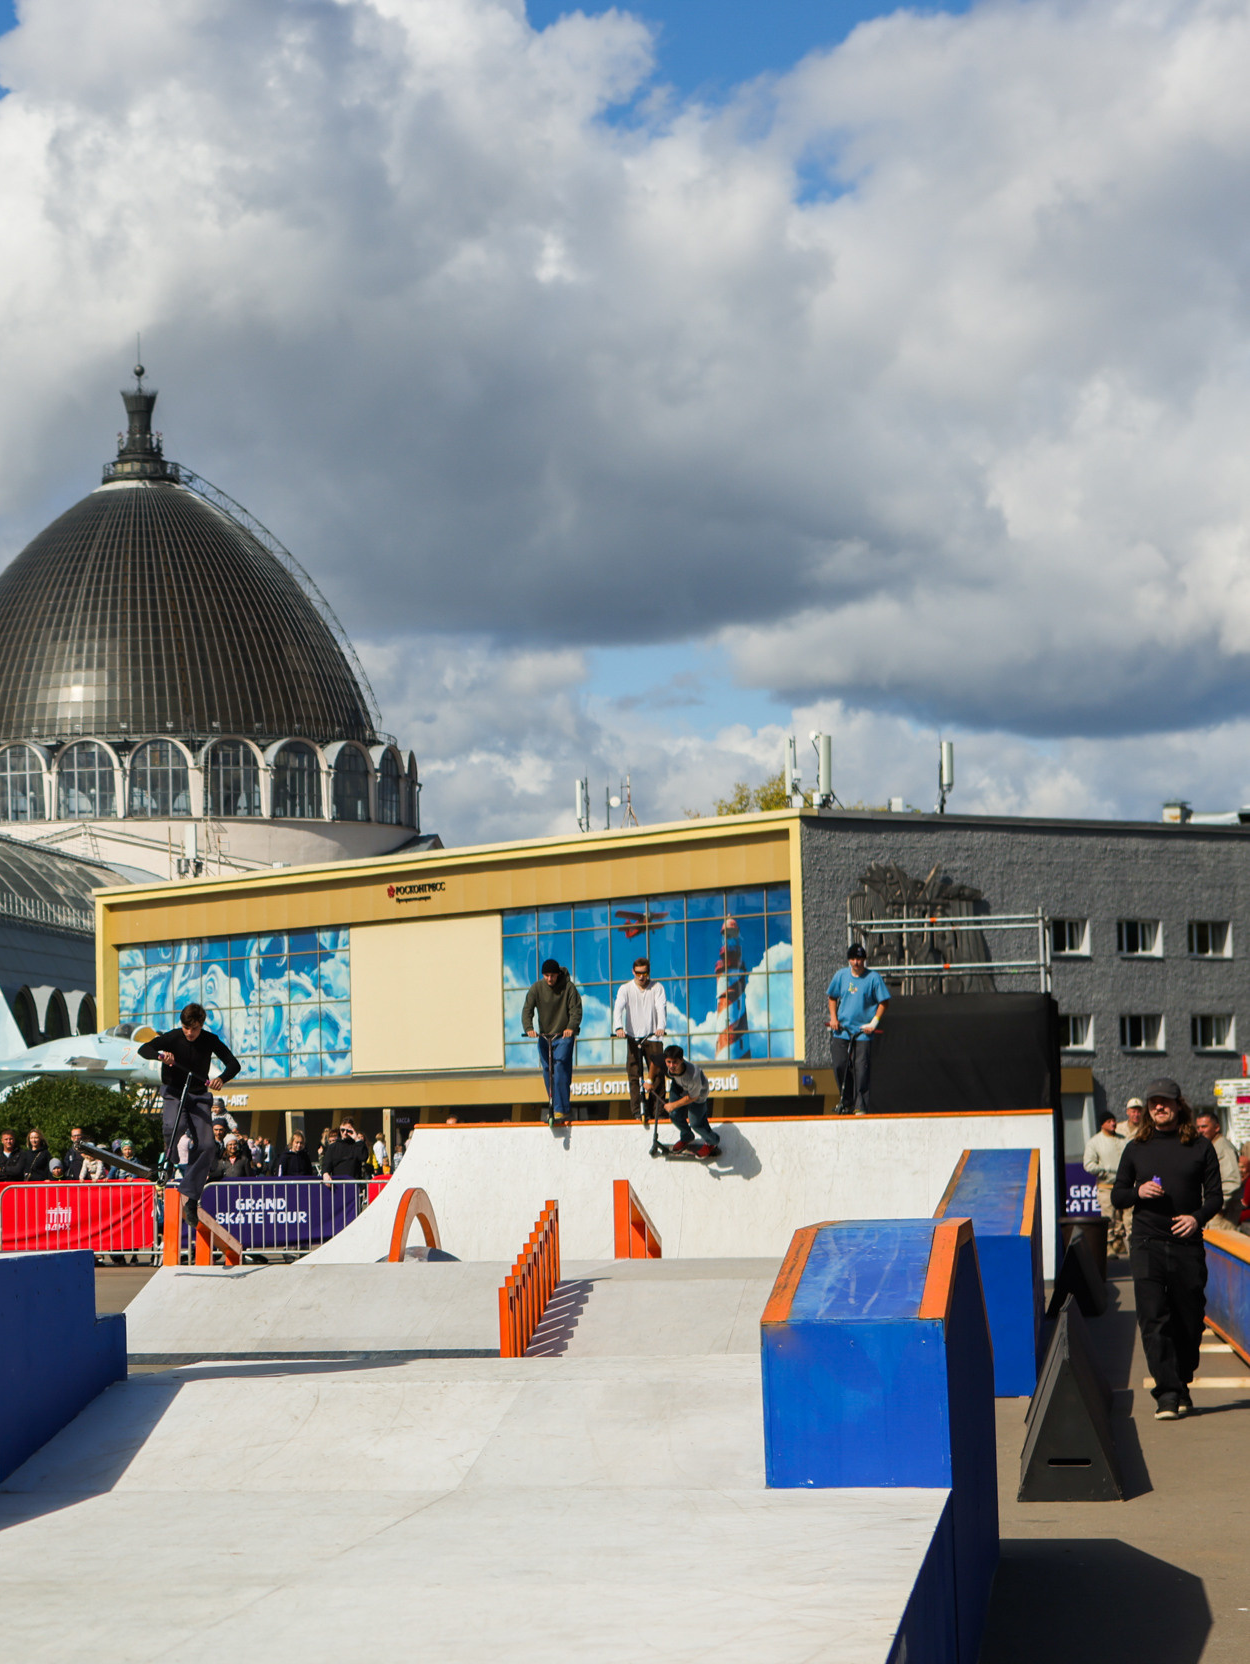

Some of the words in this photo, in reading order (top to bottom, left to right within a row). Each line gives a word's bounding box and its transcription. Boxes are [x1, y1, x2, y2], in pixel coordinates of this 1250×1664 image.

[1070, 1185, 1097, 1198] GRA
[235, 1198, 287, 1211] GRAND
[1066, 1199, 1102, 1212] ATE
[216, 1212, 264, 1224] SKATE
[267, 1211, 307, 1223] TOUR
